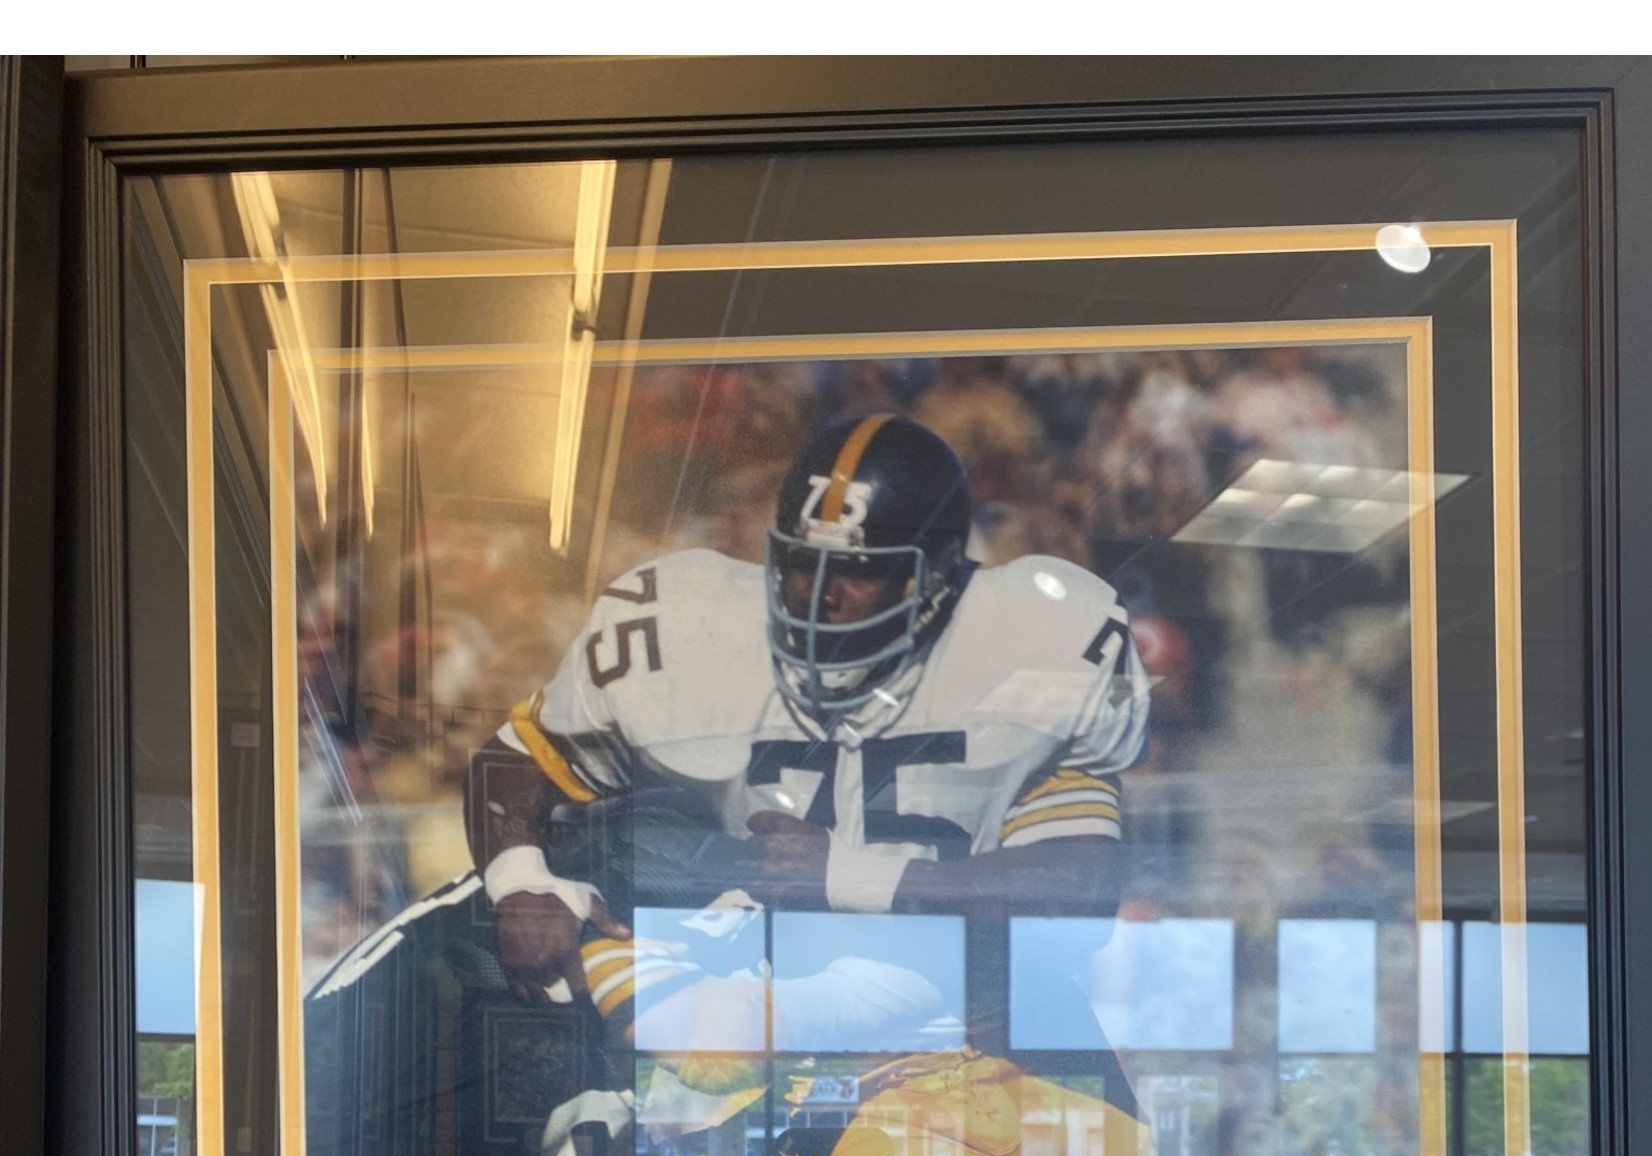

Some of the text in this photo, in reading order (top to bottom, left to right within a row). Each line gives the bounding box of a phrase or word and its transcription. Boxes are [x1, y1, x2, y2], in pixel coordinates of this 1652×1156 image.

[801, 474, 872, 526] 75
[586, 566, 662, 689] 75
[748, 730, 970, 862] 75
